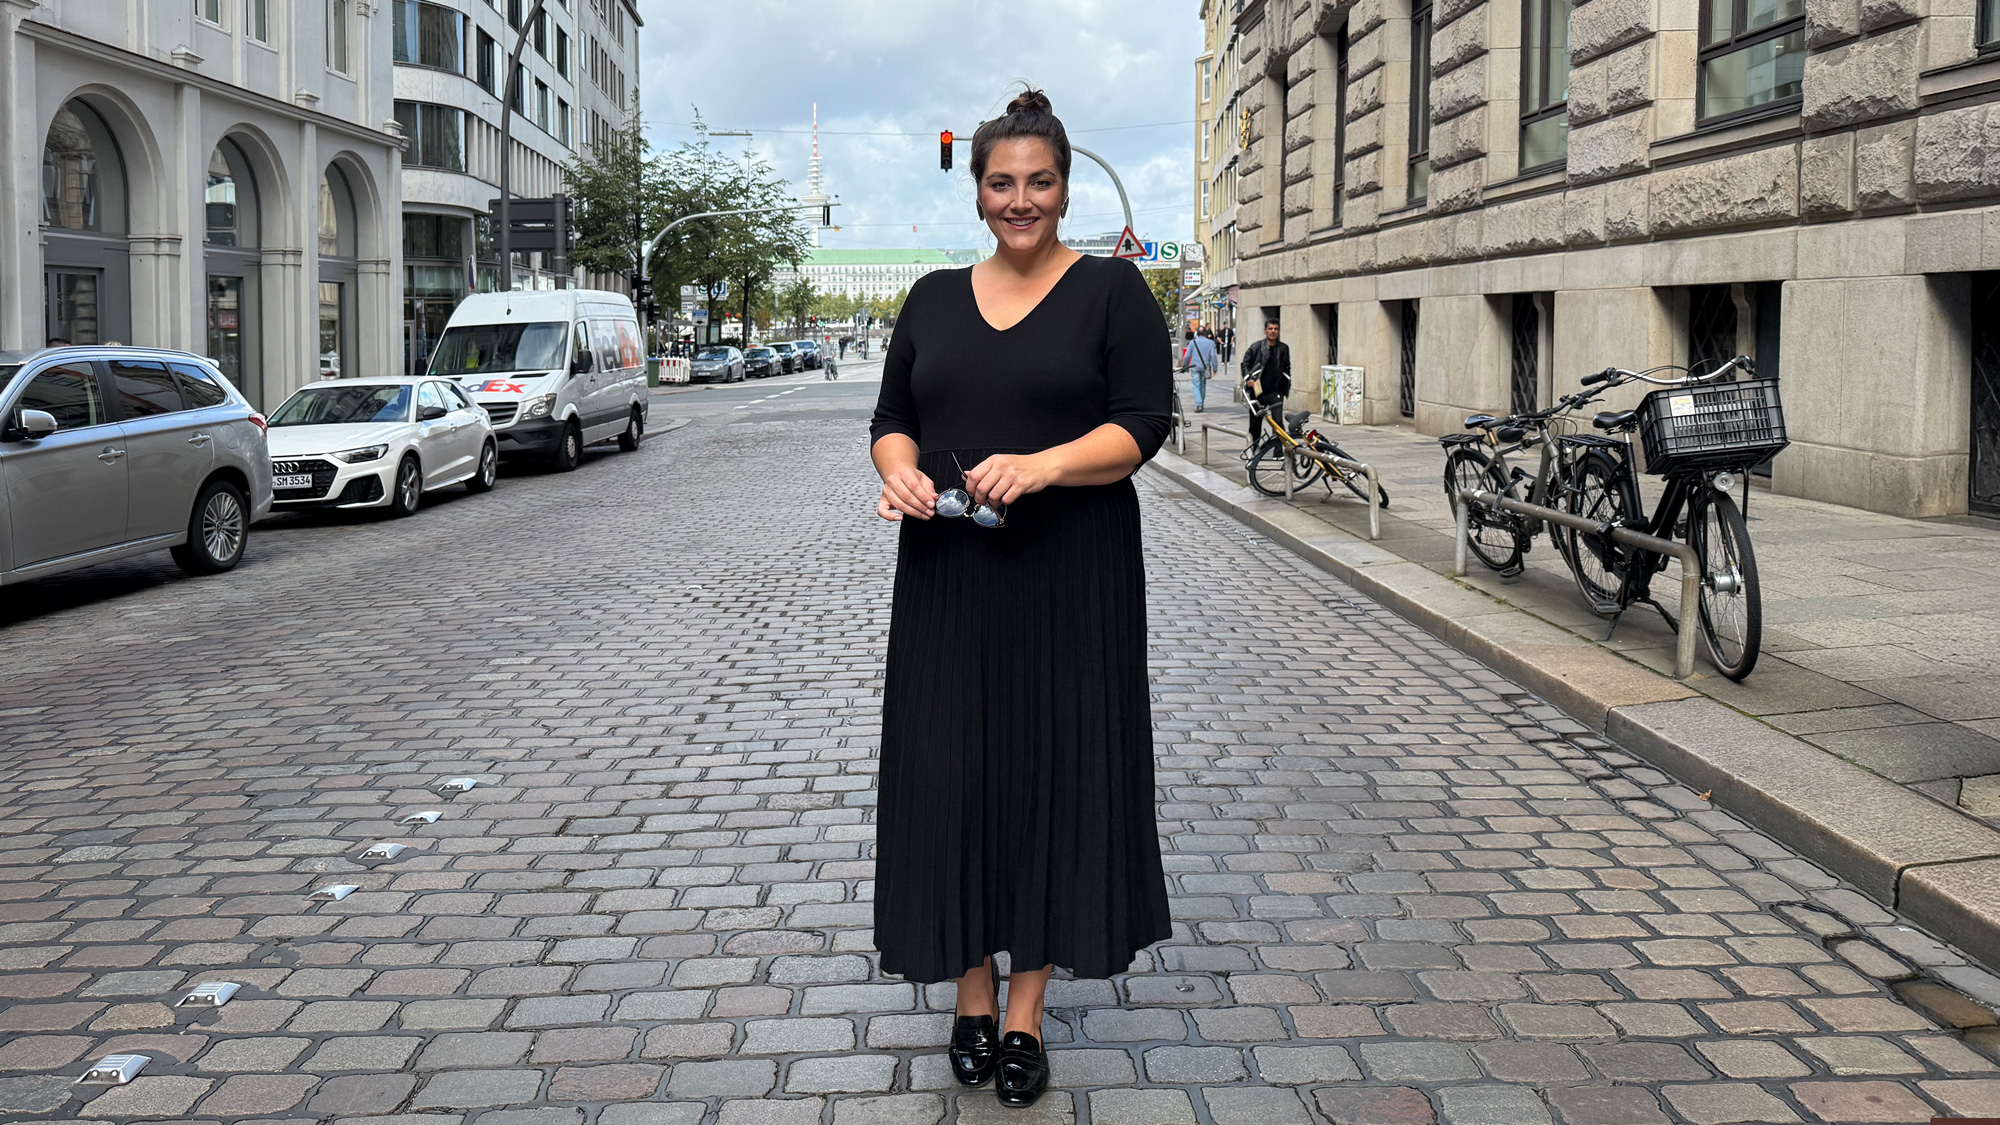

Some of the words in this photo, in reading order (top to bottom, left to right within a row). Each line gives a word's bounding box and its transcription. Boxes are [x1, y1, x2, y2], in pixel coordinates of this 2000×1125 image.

[1141, 242, 1156, 260] U
[1163, 244, 1176, 259] S
[276, 477, 288, 486] SM
[289, 476, 310, 485] 3534
